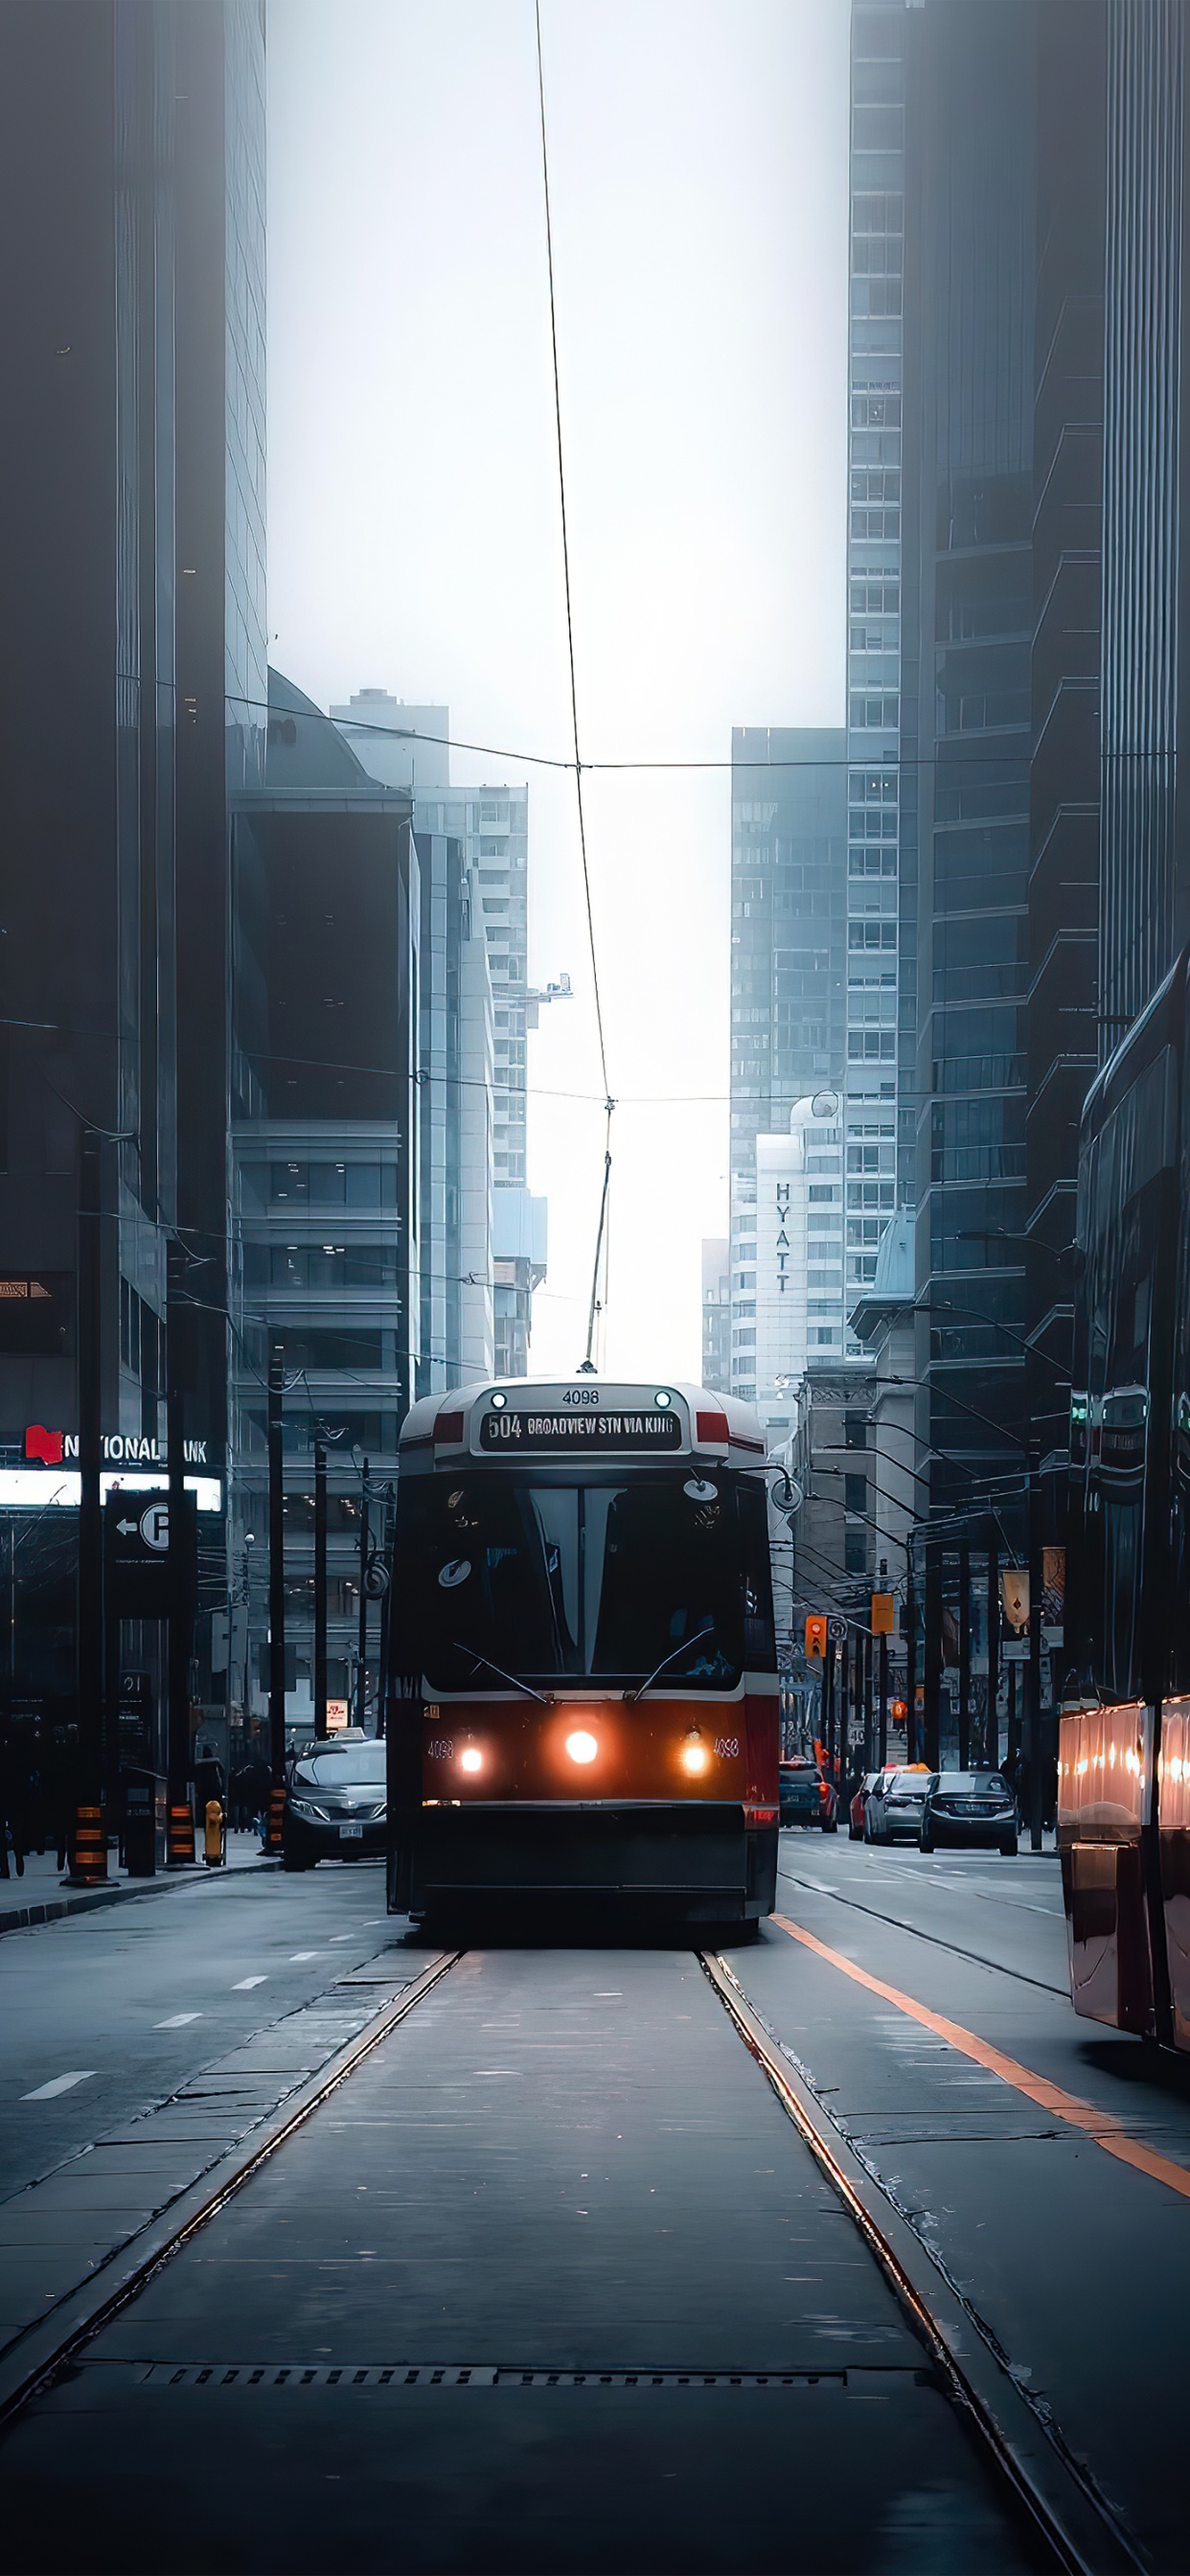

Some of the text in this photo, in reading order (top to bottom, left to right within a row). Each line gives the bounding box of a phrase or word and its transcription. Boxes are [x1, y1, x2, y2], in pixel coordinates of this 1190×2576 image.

[776, 1183, 790, 1292] HYATT
[561, 1390, 600, 1405] 4098
[489, 1414, 674, 1438] 504 BROADVIEW STN VIA KING
[64, 1435, 161, 1460] NIONAL
